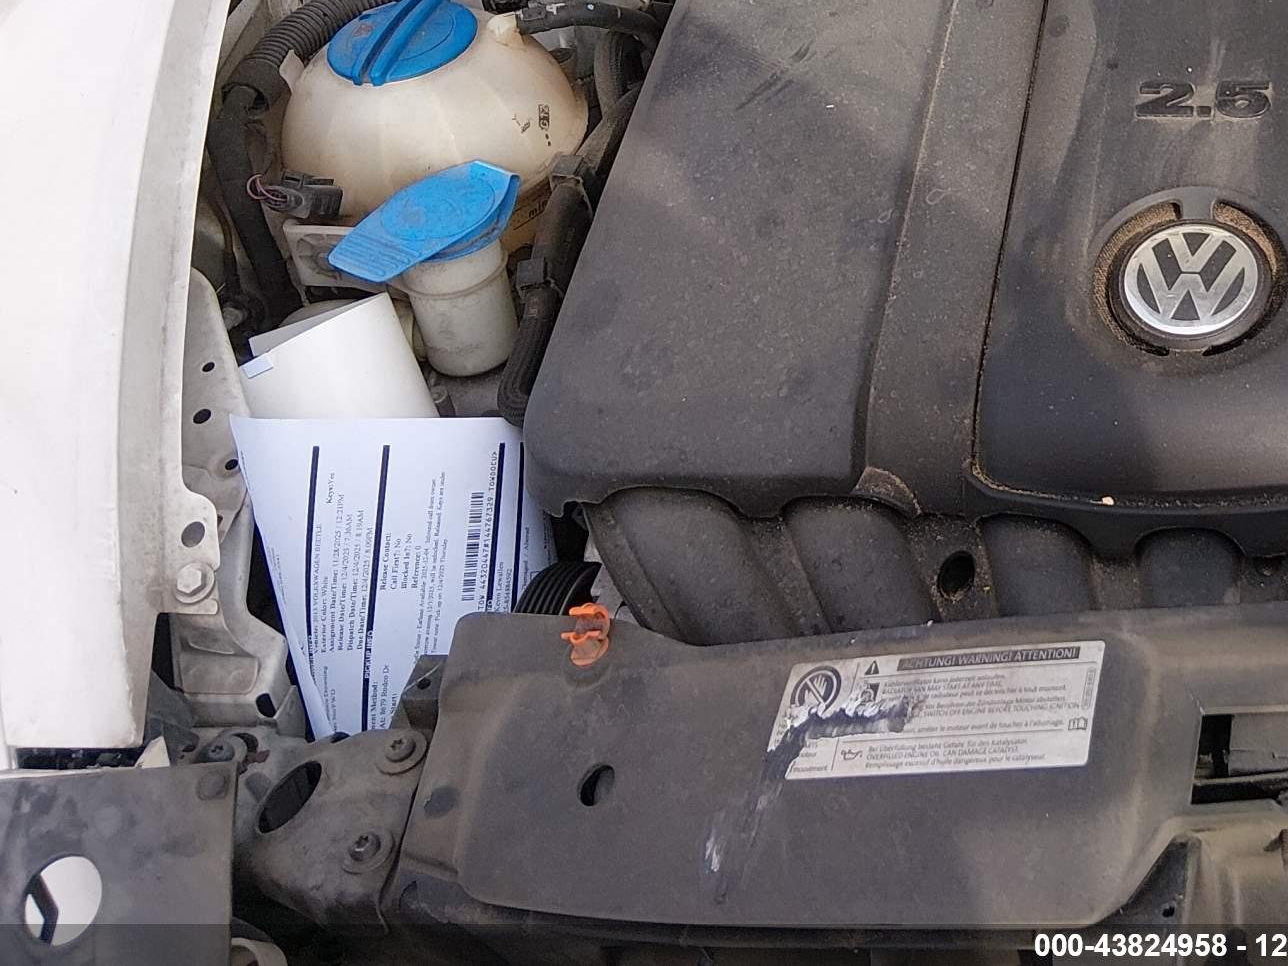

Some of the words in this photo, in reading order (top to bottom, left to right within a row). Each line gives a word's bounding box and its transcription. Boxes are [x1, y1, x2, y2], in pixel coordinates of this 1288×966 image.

[1135, 81, 1272, 118] 2.5
[314, 523, 322, 552] BEETLE
[382, 532, 391, 562] Contact:
[394, 537, 401, 547] No
[404, 533, 412, 543] No
[380, 564, 388, 590] Release
[401, 561, 409, 588] Blocked
[411, 550, 420, 588] Reference:
[496, 561, 504, 590] Lewallen
[329, 569, 338, 608] Date/Time:
[338, 582, 347, 621] Date/Time:
[348, 578, 358, 617] Date/Time:
[494, 592, 502, 612] Kevin
[357, 594, 366, 633] Date/Time:
[328, 610, 338, 652] Assignment
[346, 620, 356, 650] Dispatch
[356, 636, 364, 649] Due
[902, 656, 955, 669] ACHTUNG!
[959, 652, 1012, 665] WARNING!
[1016, 648, 1076, 662] ATTENTION!
[370, 681, 378, 711] Method:
[958, 746, 986, 754] DAMAGE
